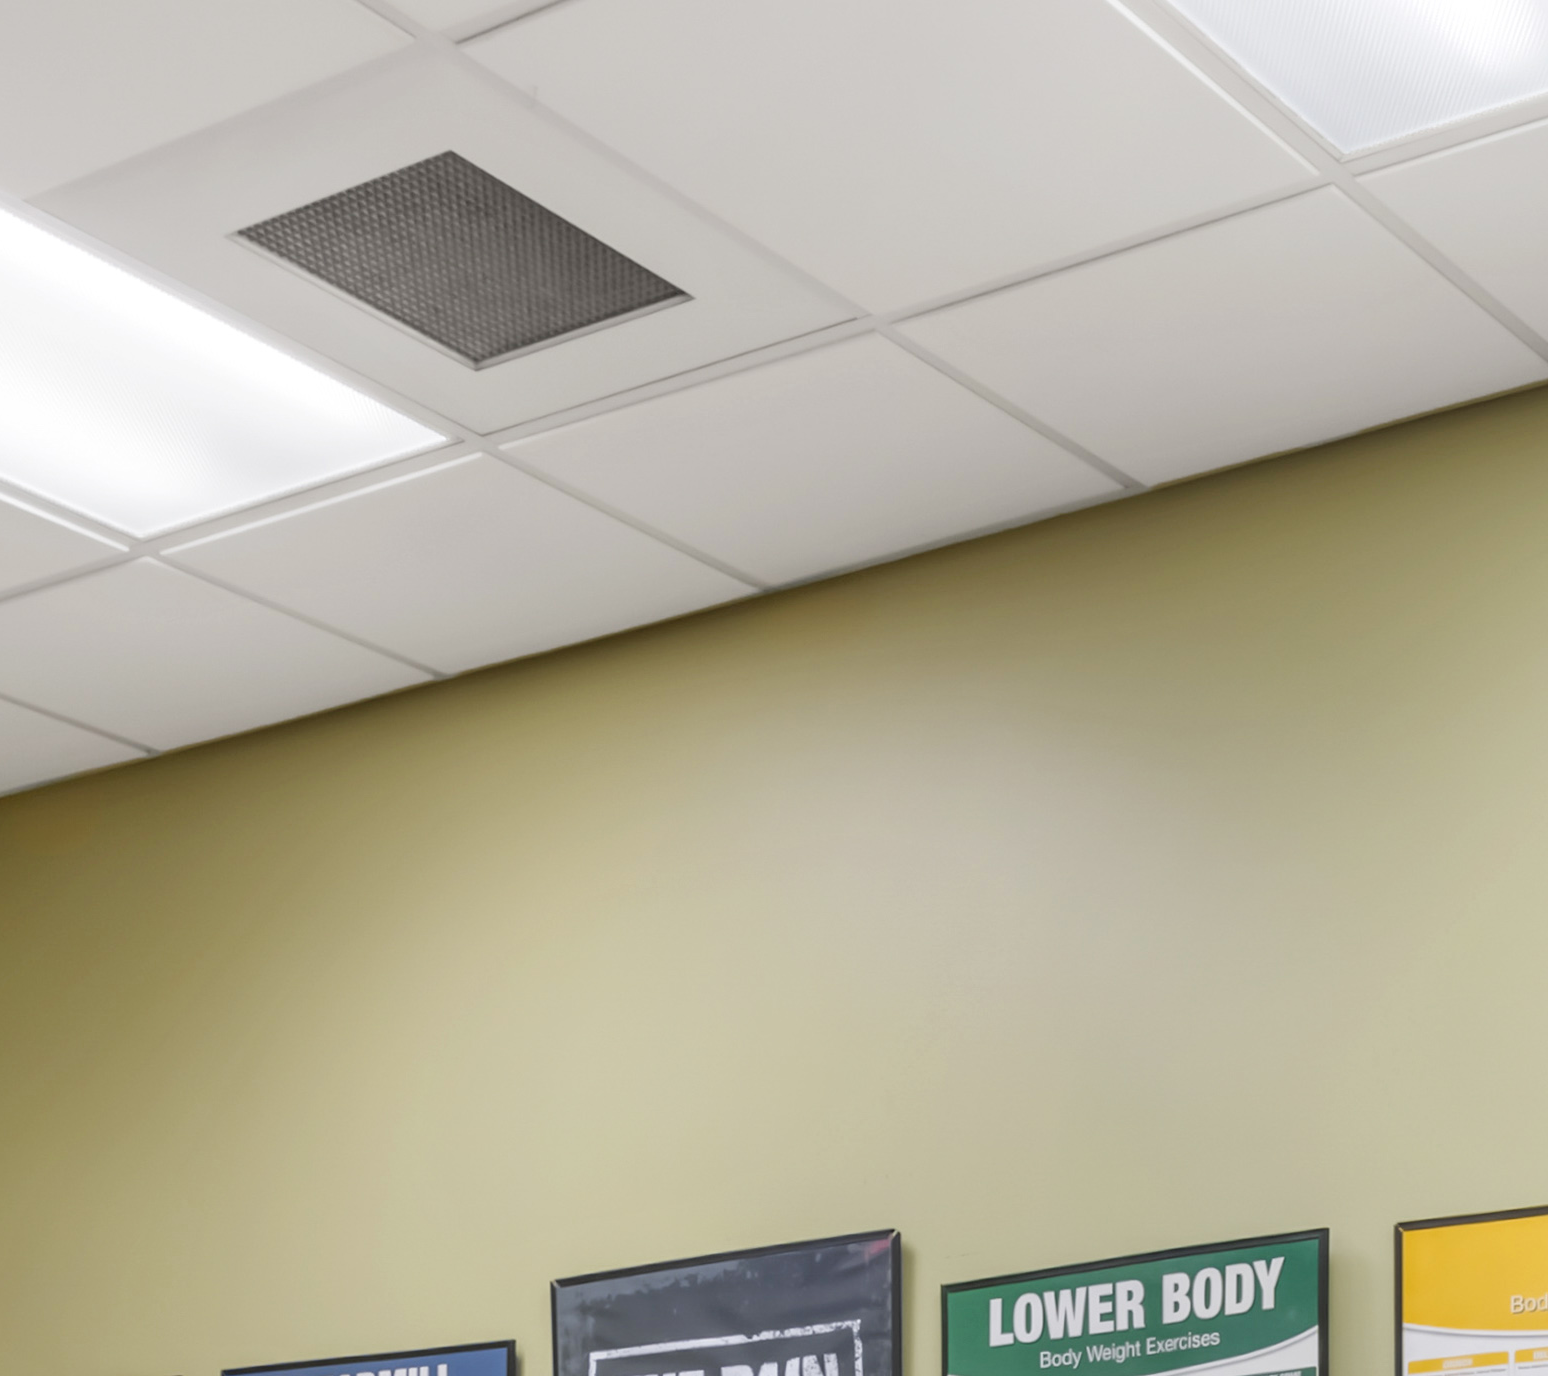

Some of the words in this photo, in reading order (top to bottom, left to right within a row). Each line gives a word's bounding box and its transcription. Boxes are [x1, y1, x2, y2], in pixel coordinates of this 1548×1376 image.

[989, 1279, 1146, 1347] LOWER
[1161, 1256, 1285, 1325] BODY
[1040, 1348, 1082, 1370] Body
[1086, 1339, 1141, 1363] Weight
[1146, 1331, 1221, 1355] Exercises
